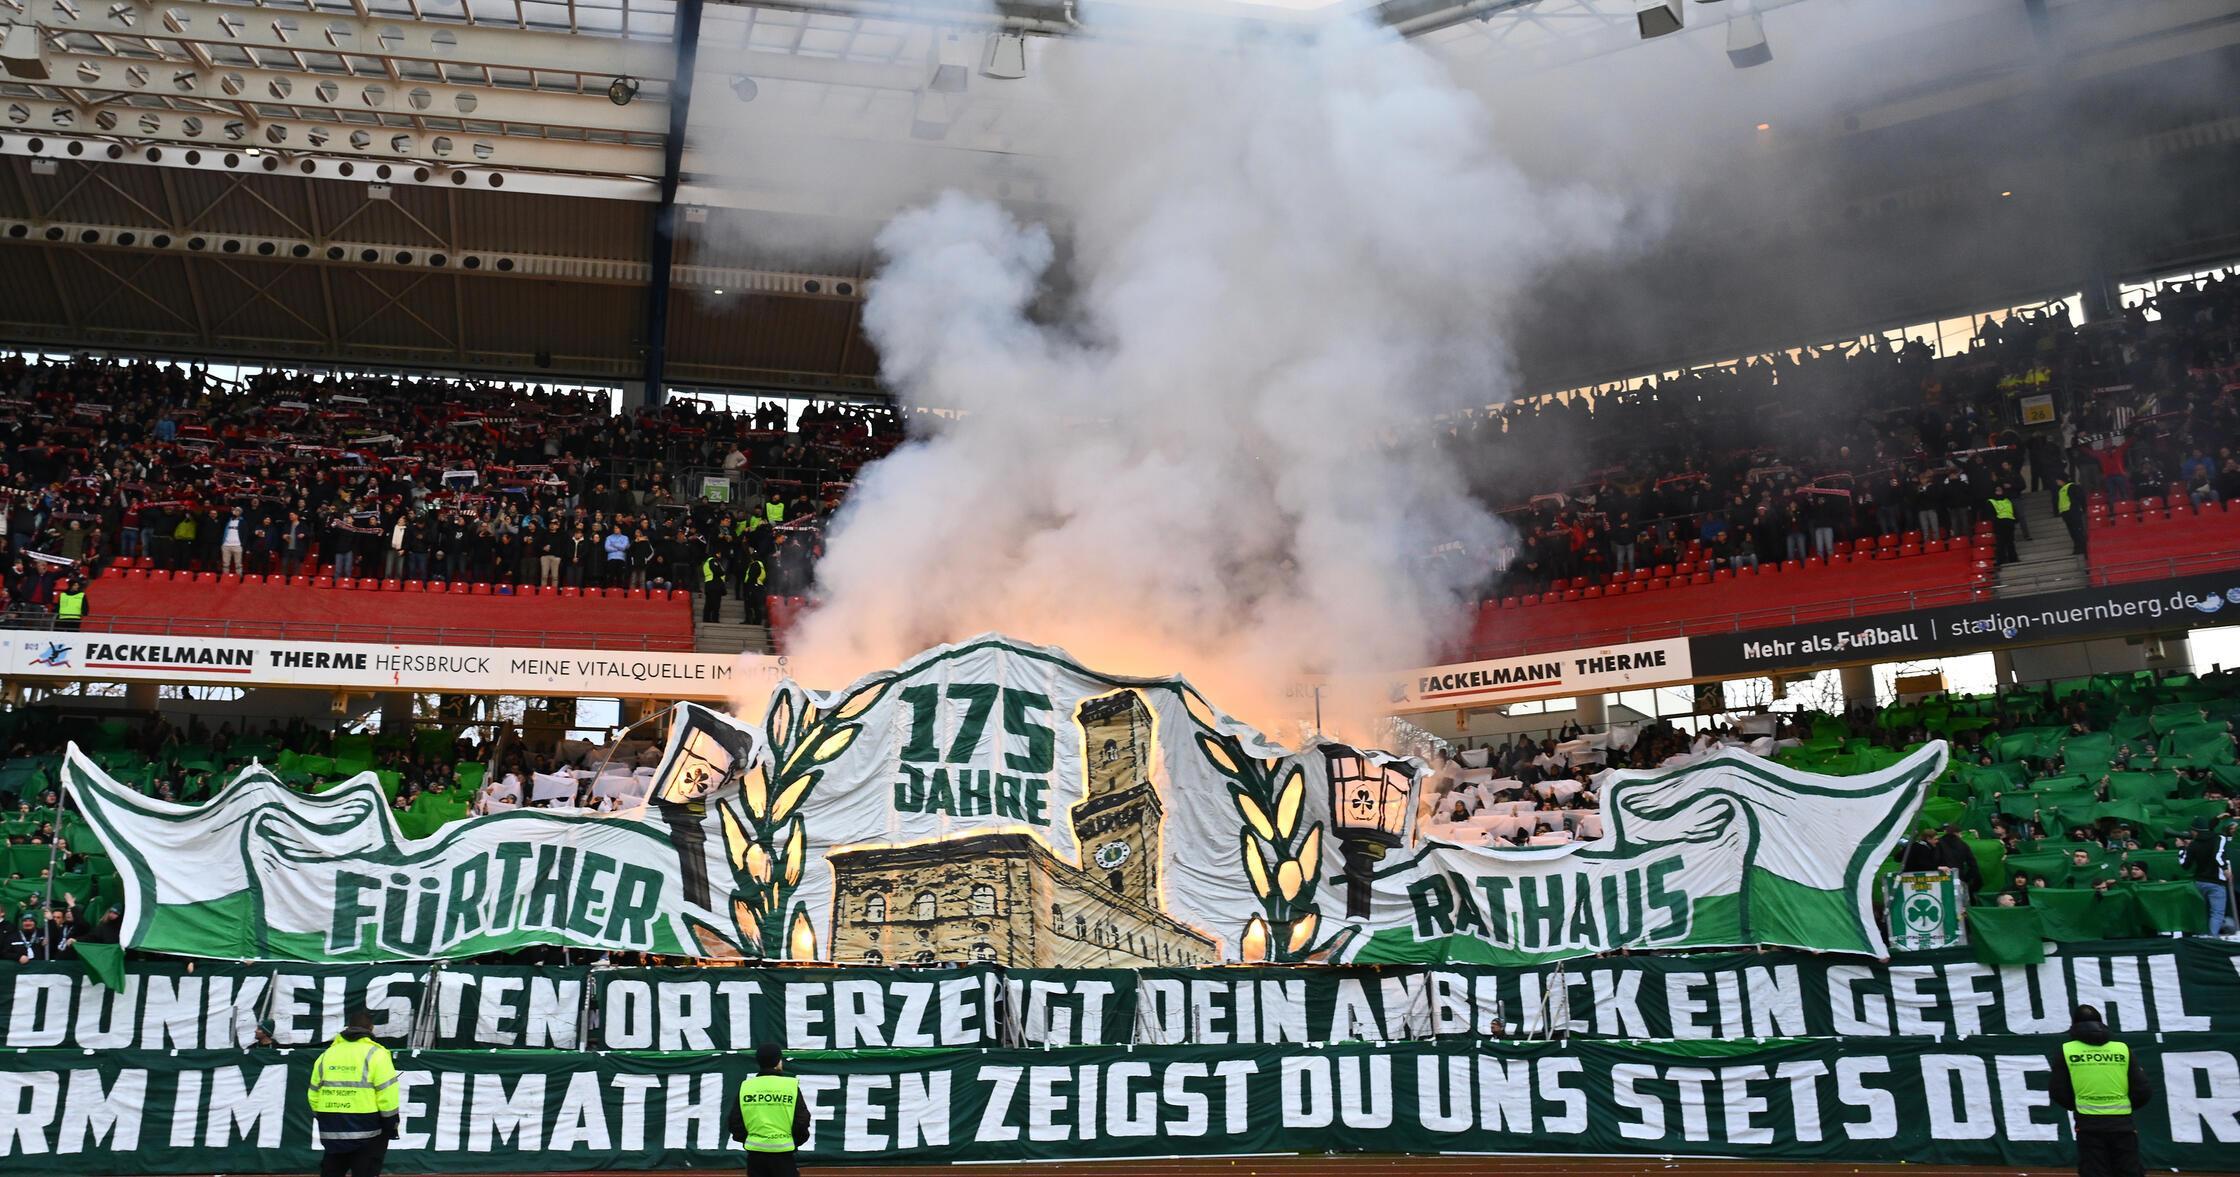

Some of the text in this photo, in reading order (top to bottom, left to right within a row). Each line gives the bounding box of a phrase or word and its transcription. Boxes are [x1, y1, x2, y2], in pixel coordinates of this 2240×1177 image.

[85, 643, 490, 673] FACKELMANN THERME HERSBRUCK
[1743, 591, 2198, 660] Mehr als Fußball stadion-nuernberg.de
[511, 659, 570, 676] MEINE
[577, 660, 705, 681] VITALQUELLE
[712, 665, 732, 680] IM
[1419, 650, 1667, 692] FACKELMANN THERME
[898, 683, 1056, 774] 175
[894, 762, 1051, 827] JAHRE
[330, 841, 665, 956] FÜRTHER
[1406, 854, 1689, 949] RATHAUS
[6, 972, 581, 1050] DUNKELSTEN
[604, 980, 764, 1051] ORT
[1137, 979, 1309, 1044] DEIN
[1329, 969, 1652, 1041] ANBLICK
[1665, 963, 1808, 1039] EIN
[2086, 1053, 2126, 1063] POWER
[169, 1064, 289, 1149] IM
[311, 1069, 952, 1152] EIMATHFEN
[974, 1060, 1260, 1142] ZEIGST
[1281, 1053, 1394, 1130] DU
[1417, 1053, 1588, 1134] UNS
[1611, 1055, 1898, 1145] STETS
[1919, 1053, 2077, 1142] DE
[758, 1093, 793, 1104] POWER
